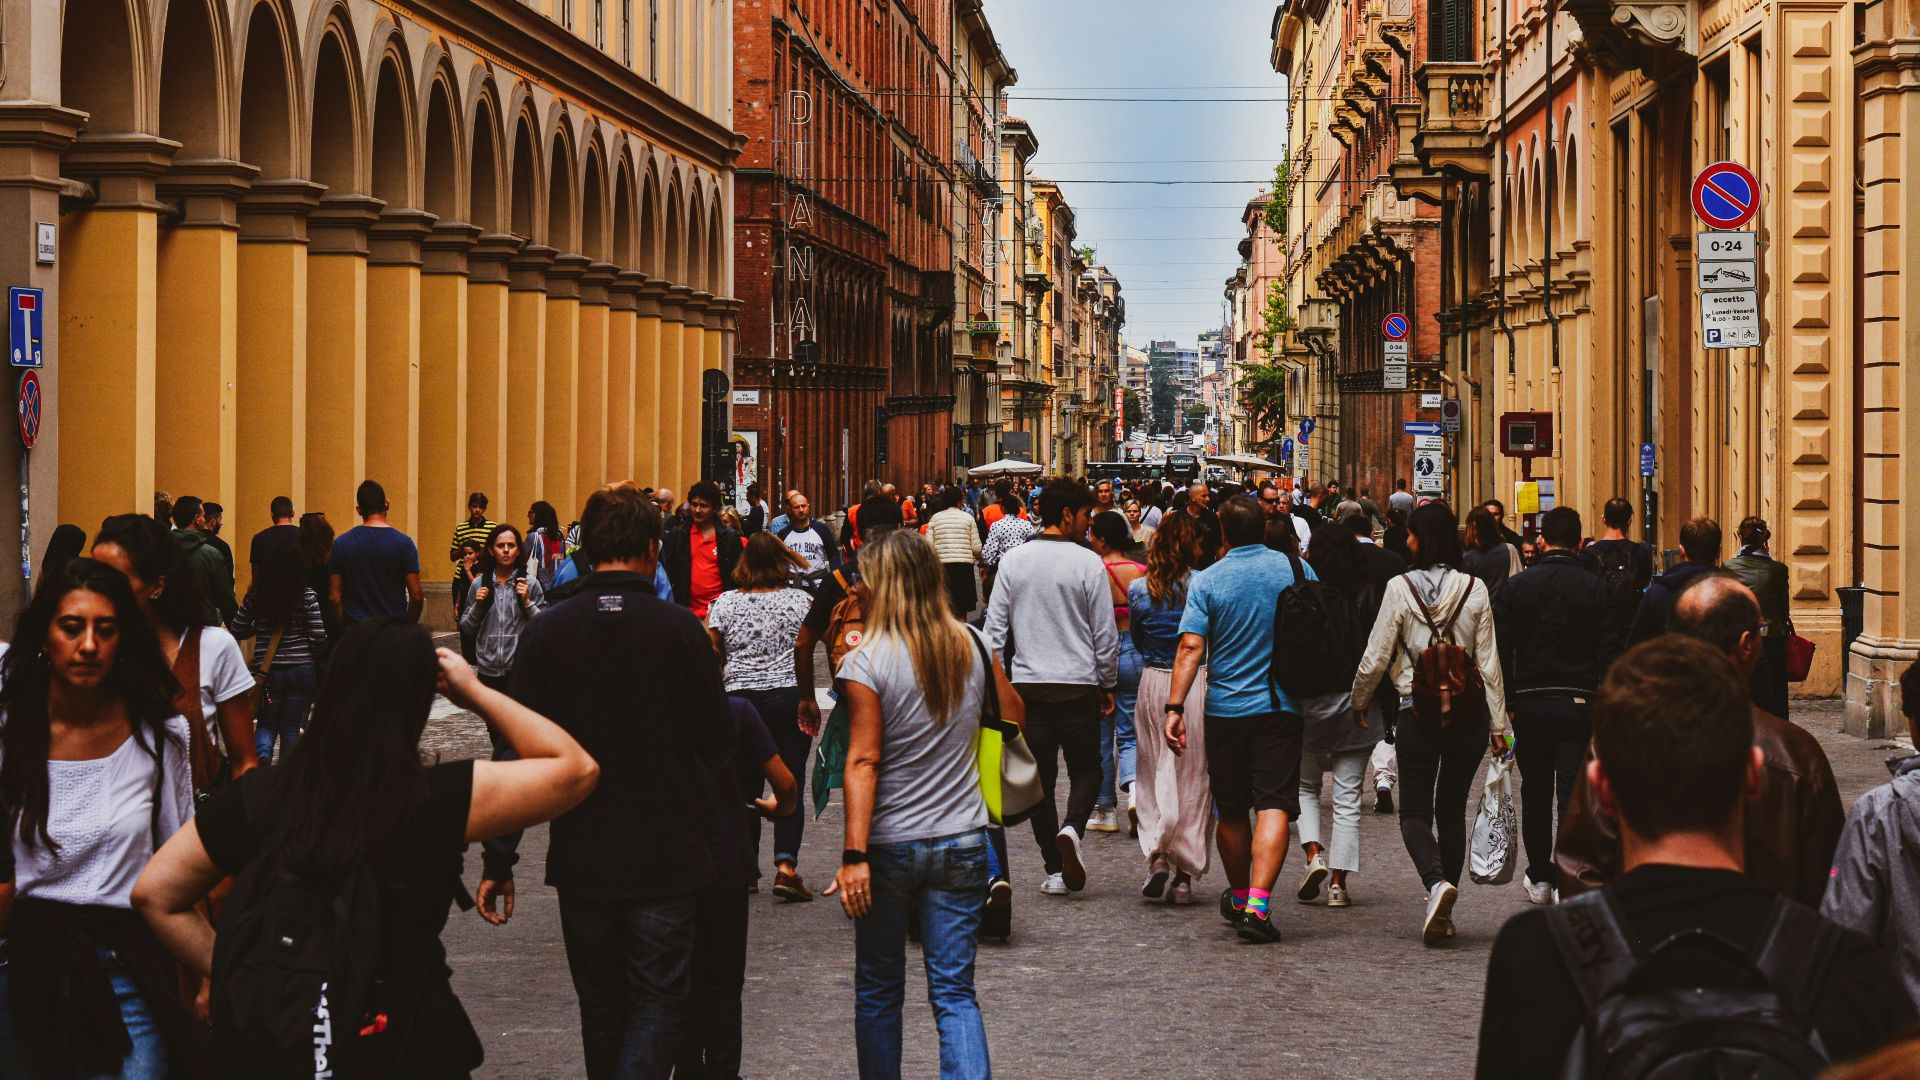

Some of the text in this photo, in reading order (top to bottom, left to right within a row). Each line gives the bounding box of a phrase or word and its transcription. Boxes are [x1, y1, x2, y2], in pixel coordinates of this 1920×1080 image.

[788, 90, 814, 333] DIANA
[980, 112, 1004, 311] HOTEL
[1711, 240, 1742, 251] 0-24
[1713, 295, 1745, 304] eccetto
